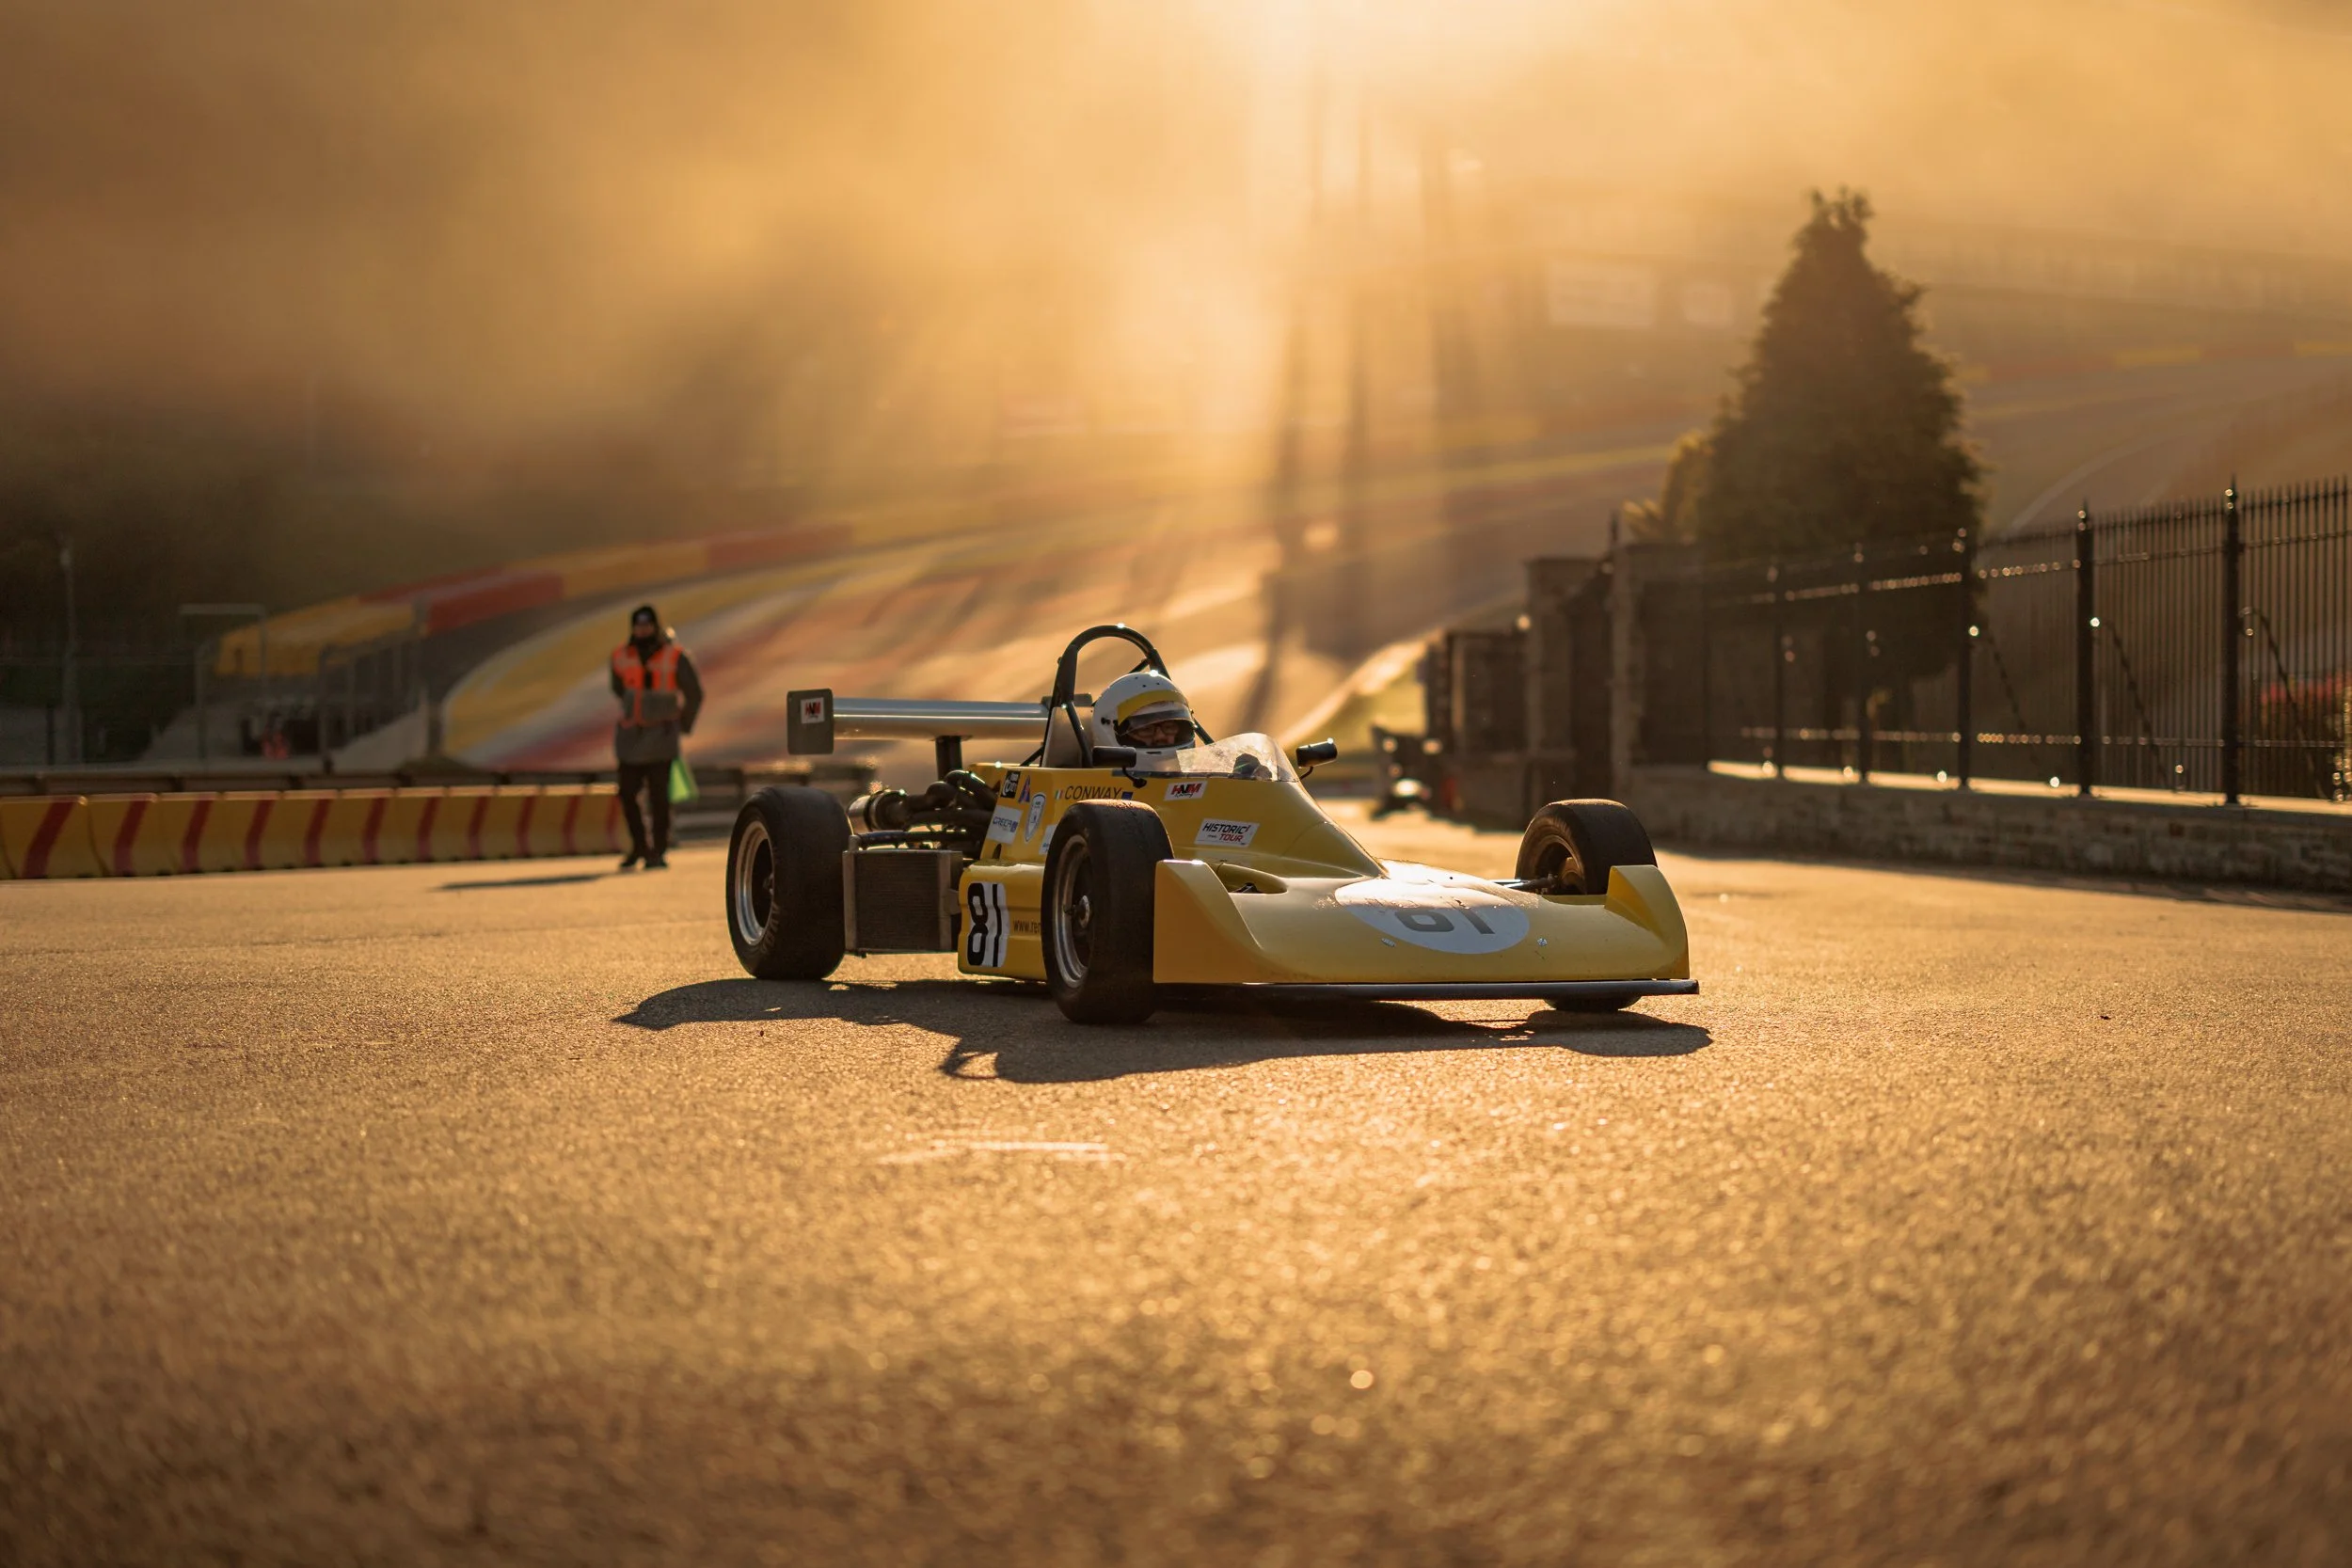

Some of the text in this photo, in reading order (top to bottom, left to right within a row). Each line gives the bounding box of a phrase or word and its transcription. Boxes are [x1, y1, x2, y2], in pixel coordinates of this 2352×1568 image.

[1064, 785, 1122, 800] CONWAY
[1202, 822, 1248, 834] HISTORIC
[1219, 833, 1244, 843] TOUR
[967, 882, 1003, 968] 81
